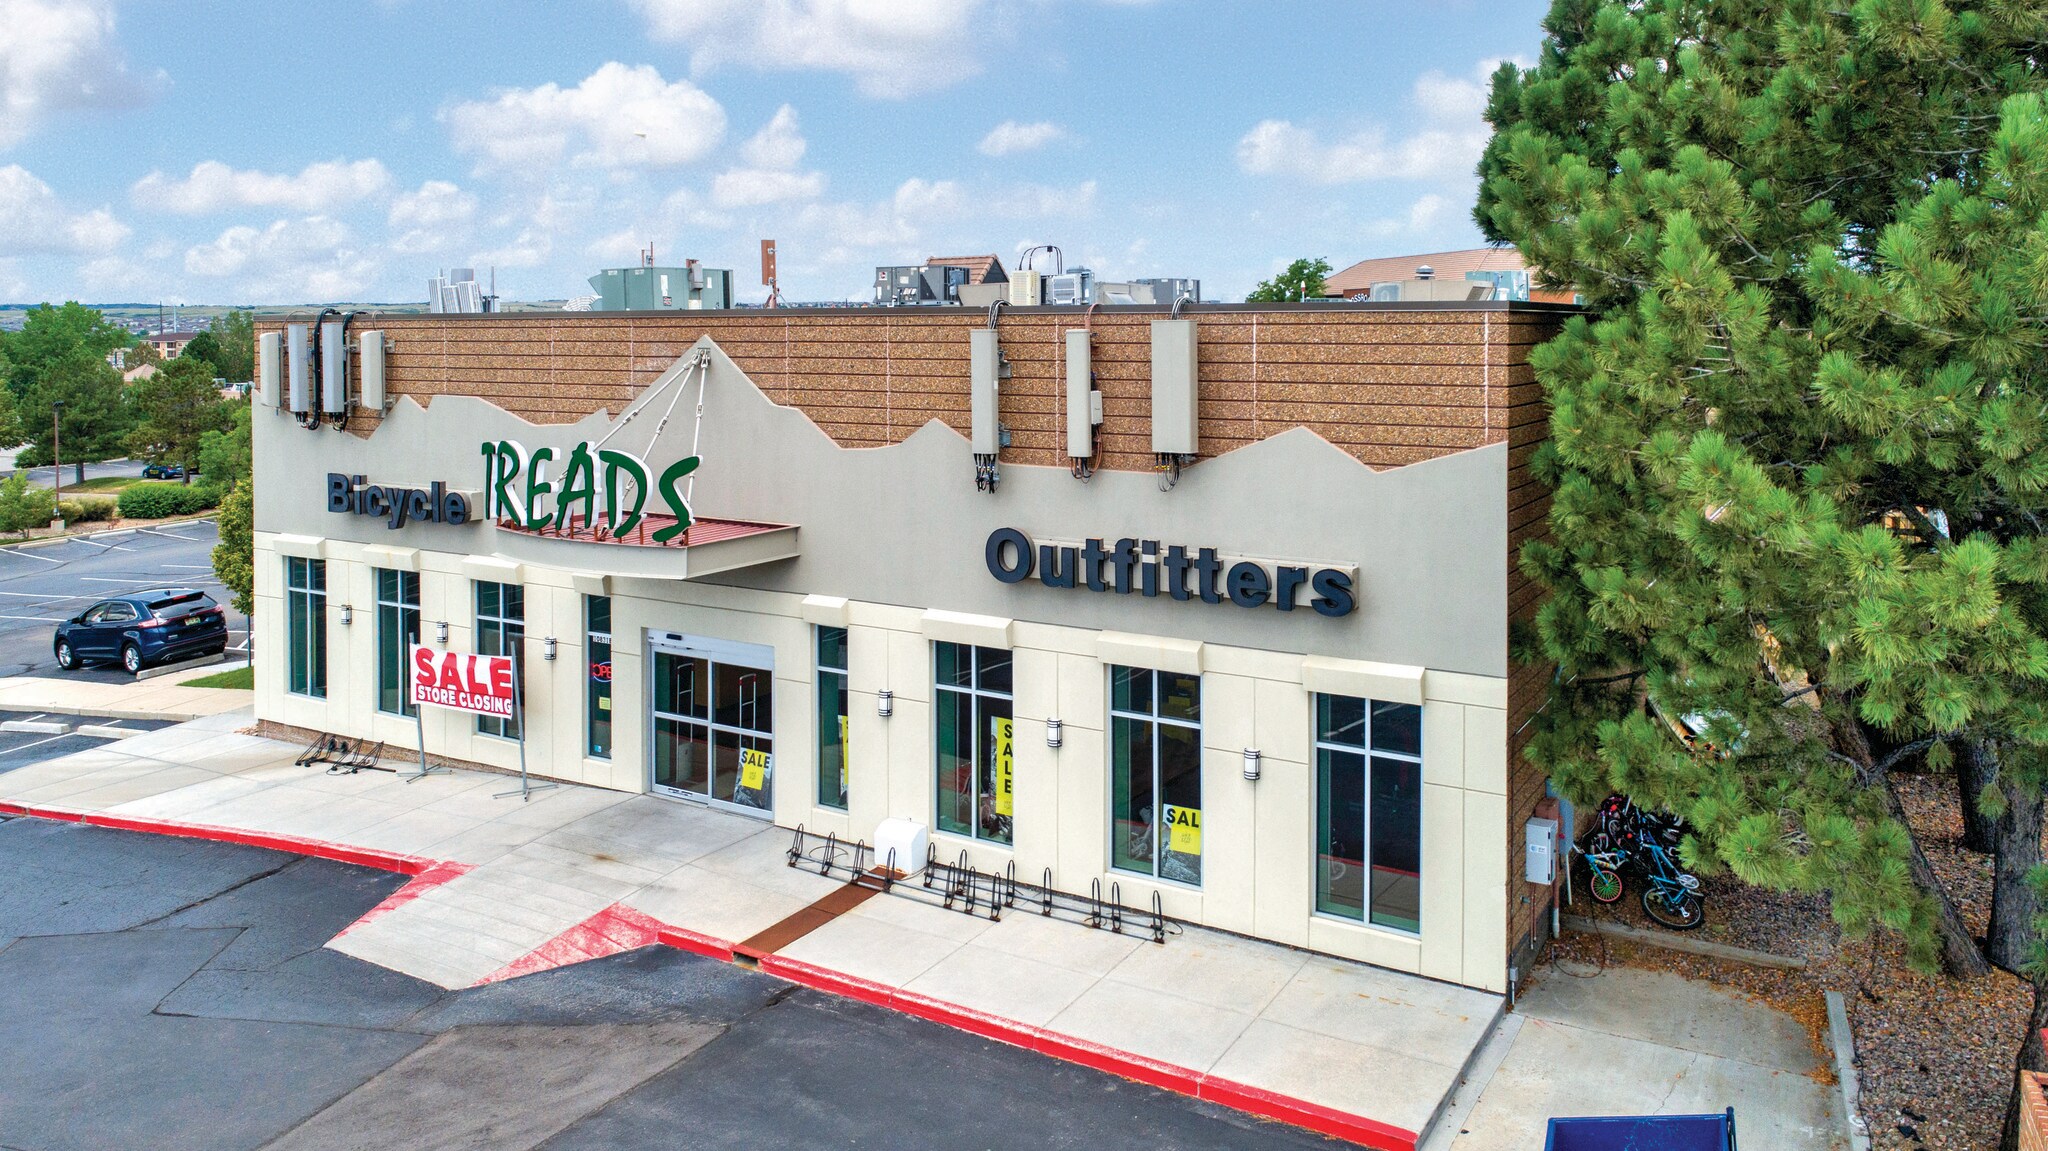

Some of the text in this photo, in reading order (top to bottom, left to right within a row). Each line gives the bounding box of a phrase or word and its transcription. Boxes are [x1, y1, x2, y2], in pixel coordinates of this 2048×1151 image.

[327, 472, 473, 530] Bicycle
[481, 440, 703, 543] TREADS
[985, 527, 1355, 618] Outfitters
[415, 647, 512, 698] SALE
[592, 664, 612, 679] OPE
[417, 685, 512, 714] STORE CLOSING
[741, 750, 771, 769] SALE
[1002, 723, 1013, 794] SALE
[1166, 807, 1200, 829] SAL
